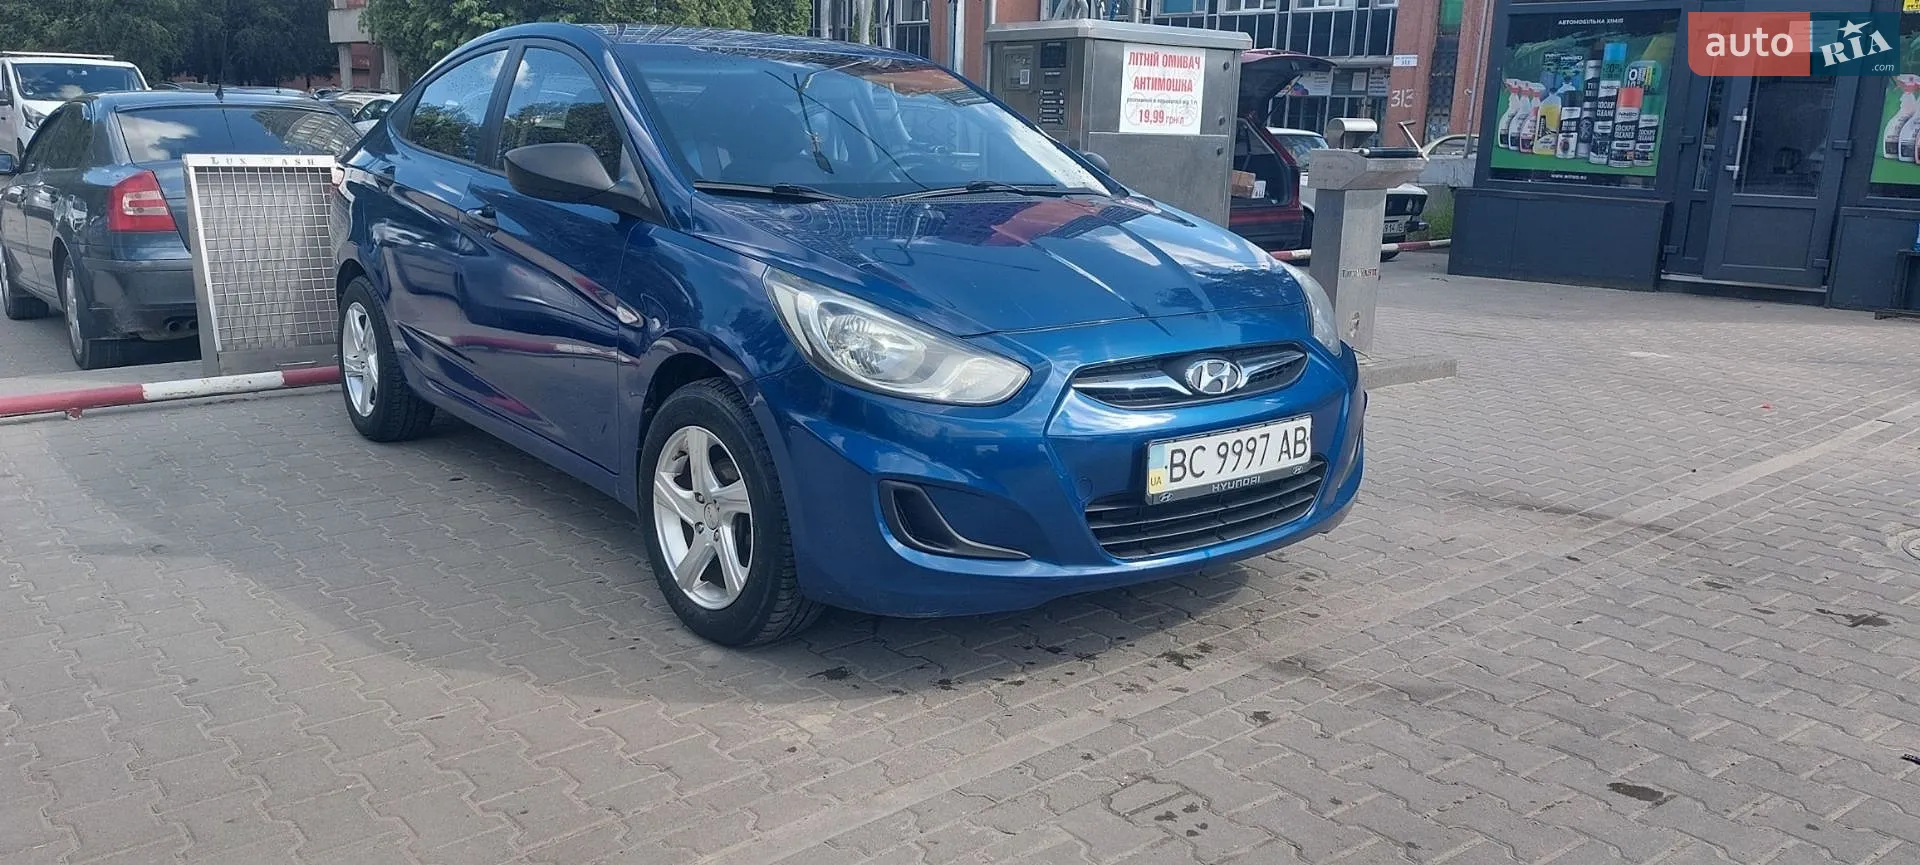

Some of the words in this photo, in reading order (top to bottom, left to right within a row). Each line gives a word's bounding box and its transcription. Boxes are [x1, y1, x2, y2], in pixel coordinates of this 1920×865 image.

[1128, 51, 1160, 67] ЛІТНІЙ
[1162, 54, 1201, 69] ОМИВАЧ
[1133, 76, 1193, 92] АНТИМОШКА
[1139, 109, 1165, 124] 19,99
[1169, 446, 1206, 483] BC
[1216, 433, 1270, 474] 9997
[1277, 426, 1308, 462] AB
[1150, 476, 1162, 486] UA
[1212, 476, 1261, 492] HYUNDAI
